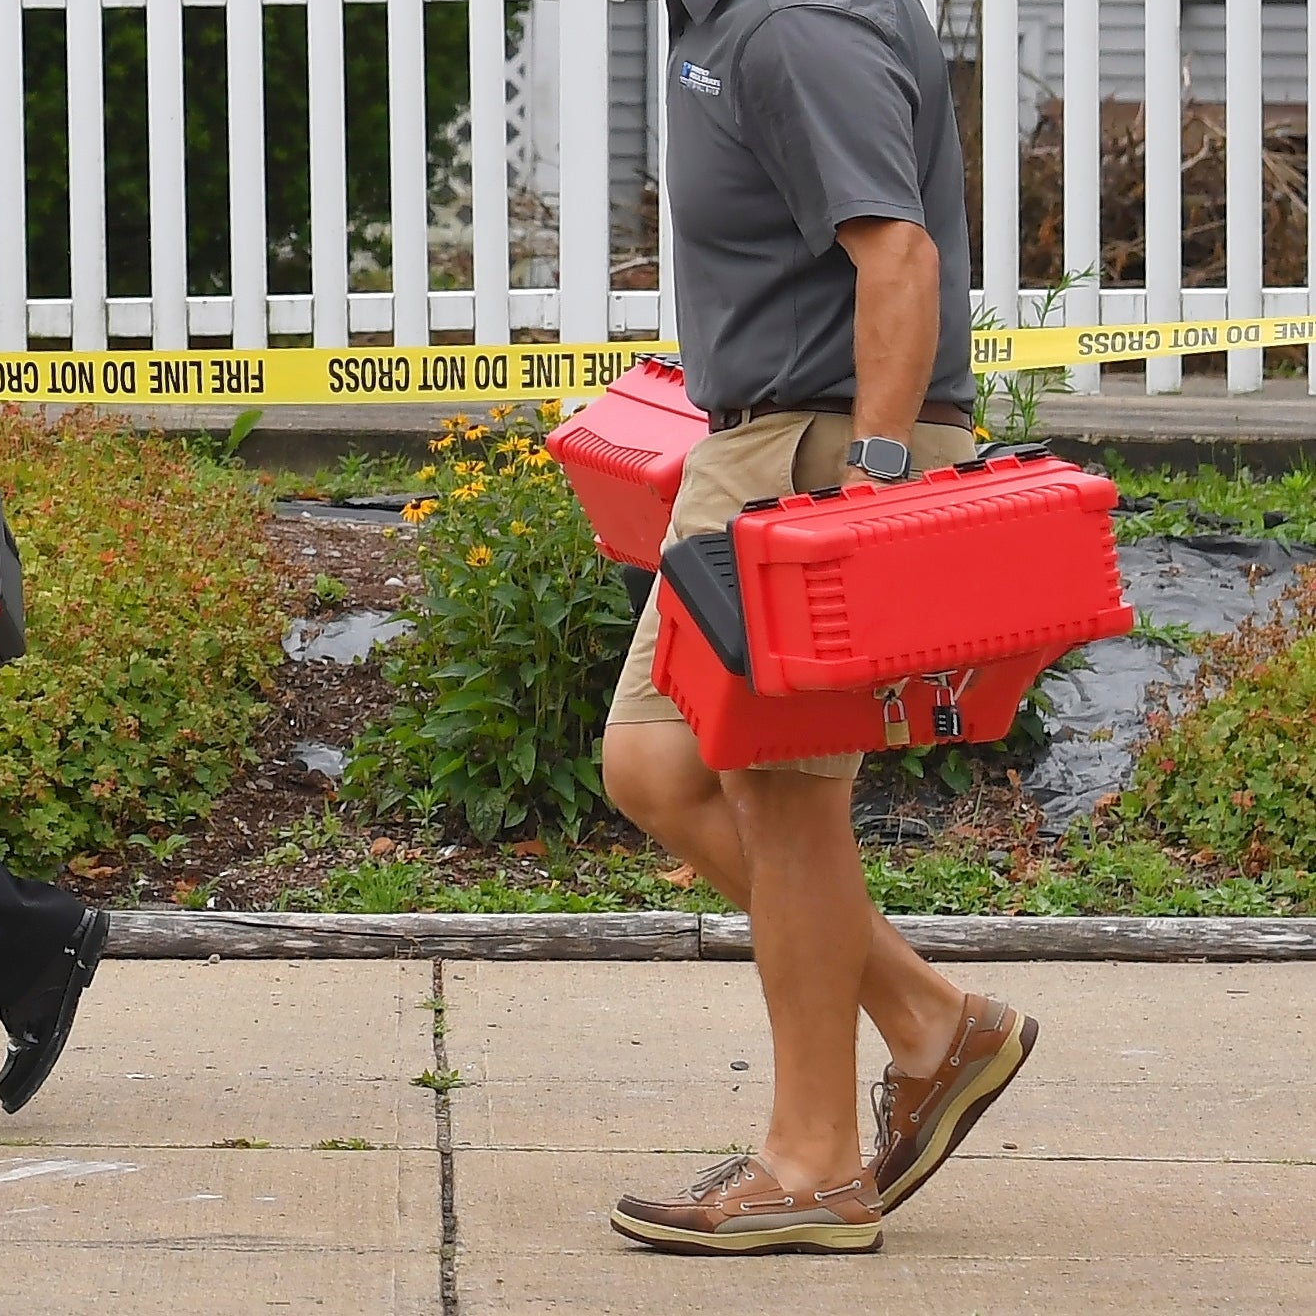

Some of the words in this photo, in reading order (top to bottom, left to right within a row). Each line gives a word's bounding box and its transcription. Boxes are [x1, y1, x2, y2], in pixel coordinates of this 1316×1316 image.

[1077, 329, 1161, 356] CROSS
[1169, 325, 1218, 349] NOT
[1226, 323, 1261, 344] DO
[1274, 321, 1316, 341] INE
[973, 337, 1013, 364] FIR
[46, 361, 95, 394] NOT
[103, 361, 136, 394] DO
[148, 360, 203, 394] LINE
[210, 359, 264, 394] FIRE
[328, 356, 410, 394] CROSS
[418, 355, 466, 392] NOT
[474, 354, 508, 390] DO
[521, 352, 575, 389] LINE
